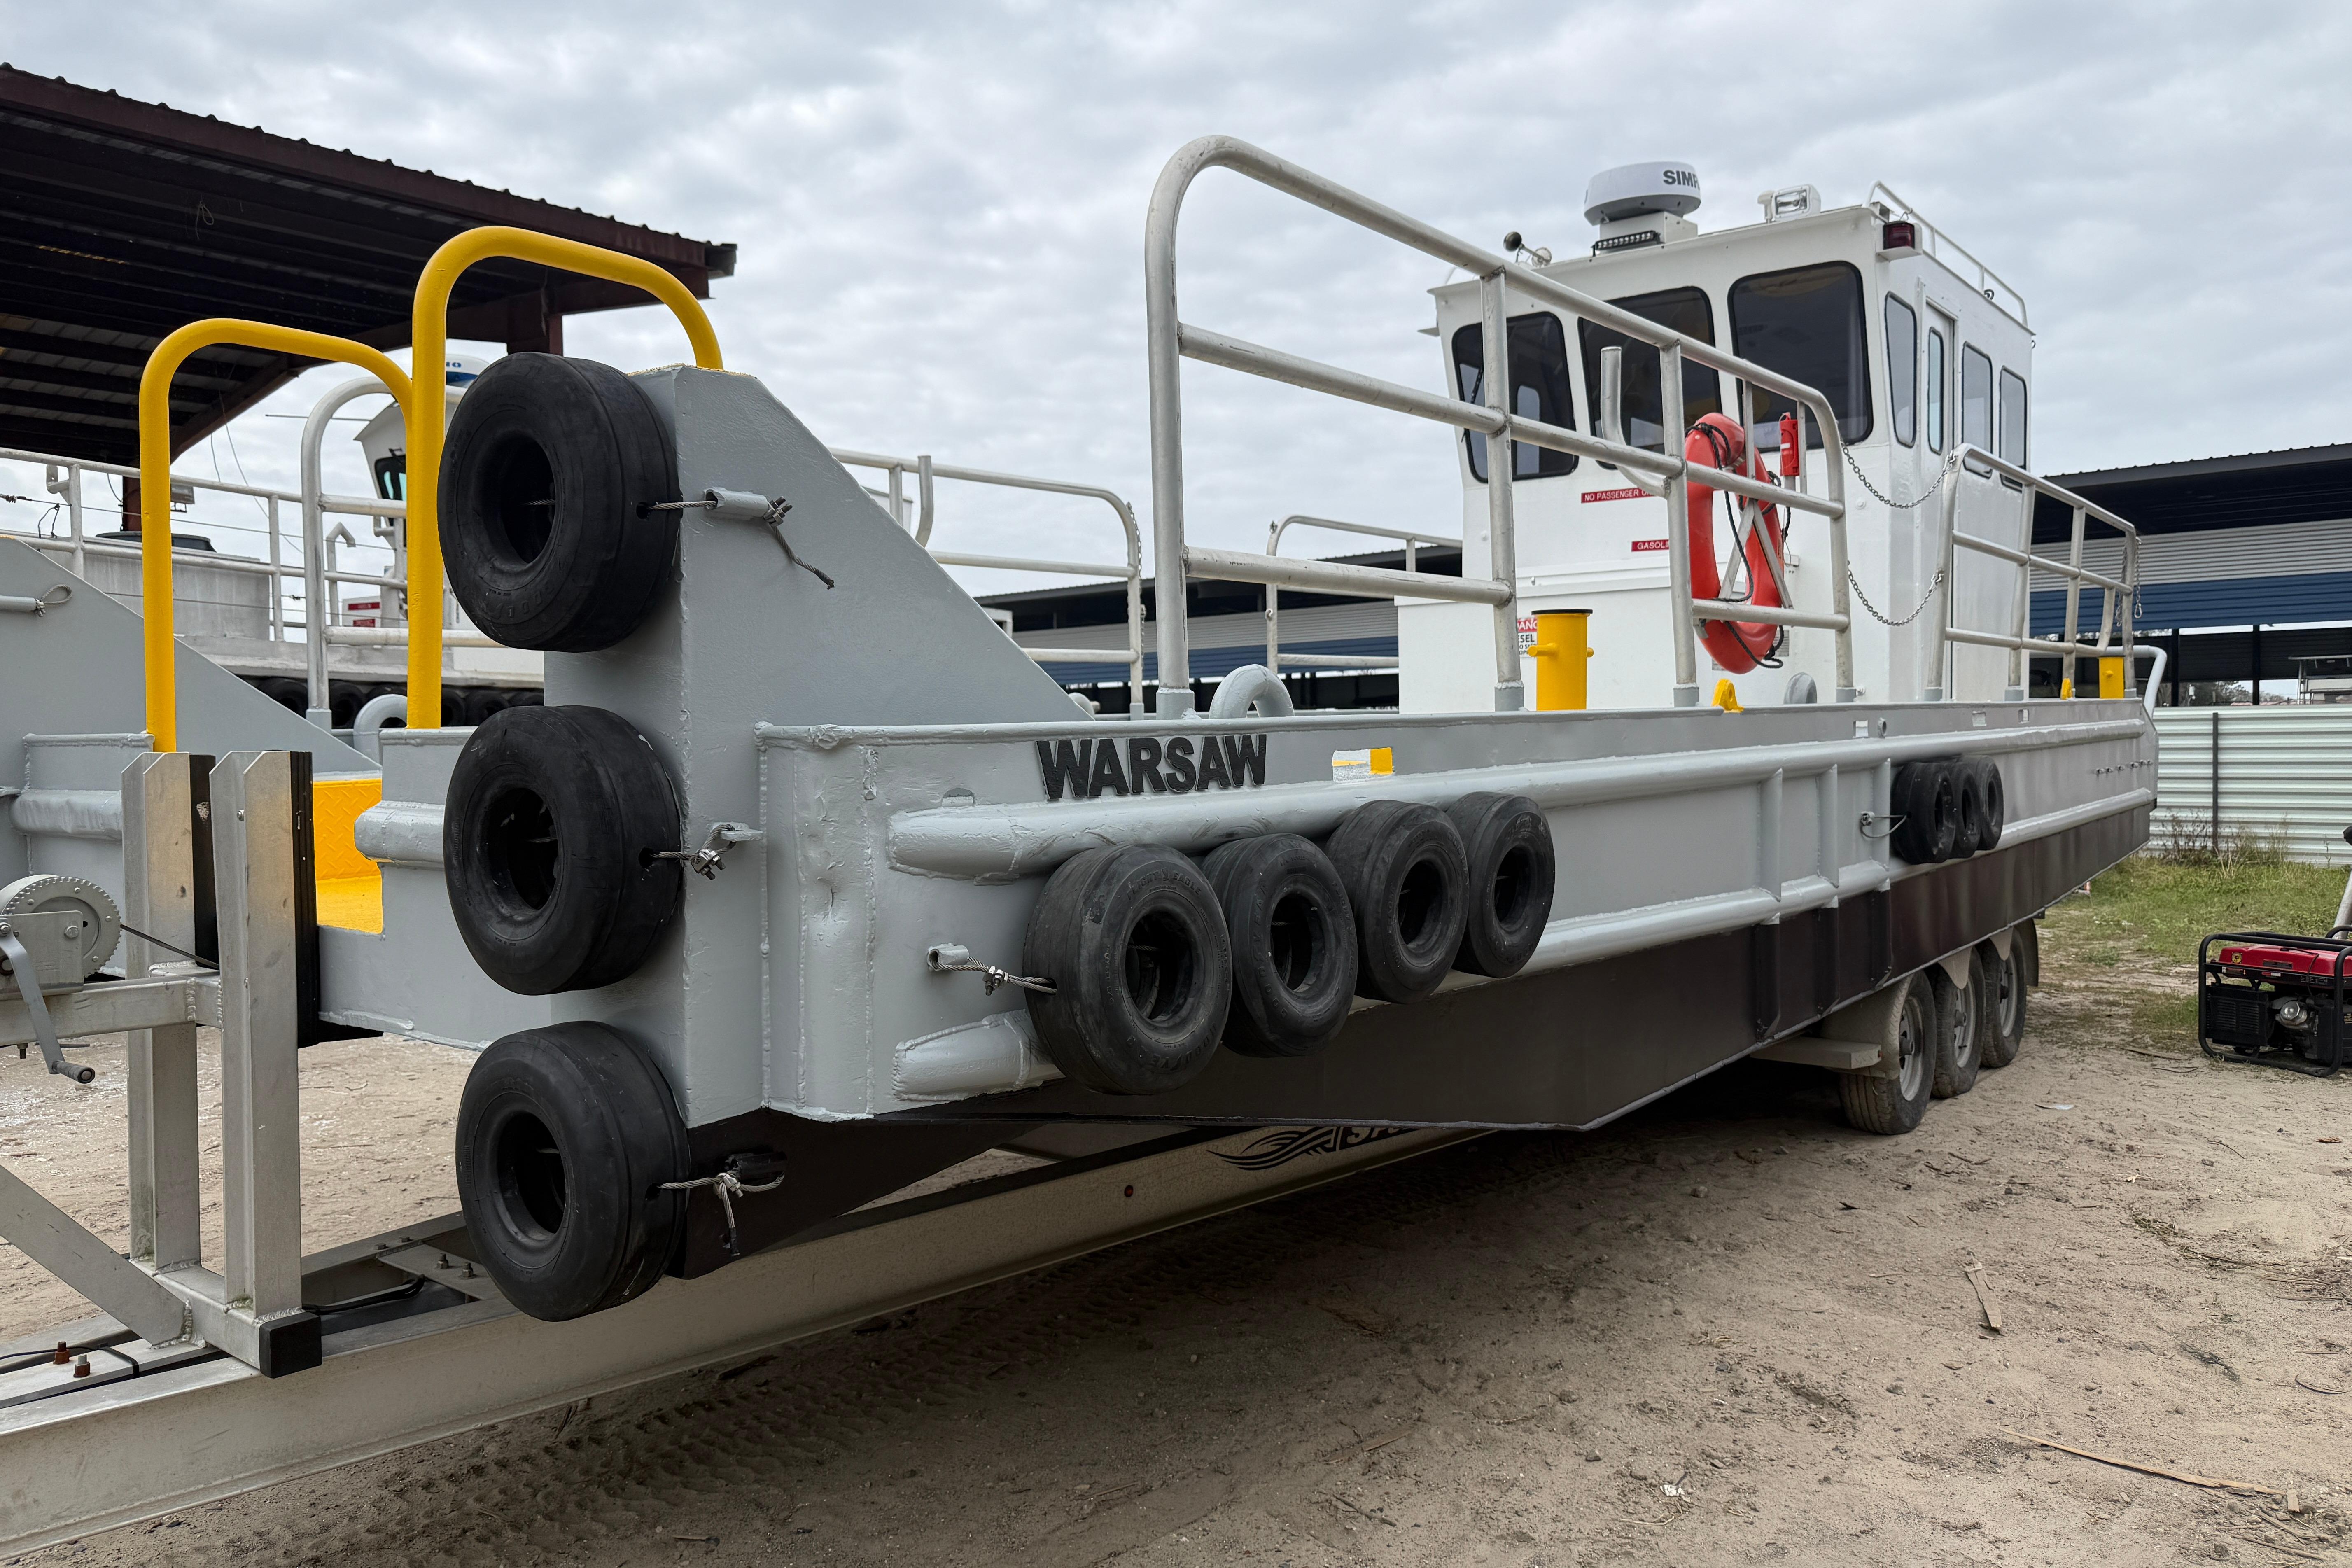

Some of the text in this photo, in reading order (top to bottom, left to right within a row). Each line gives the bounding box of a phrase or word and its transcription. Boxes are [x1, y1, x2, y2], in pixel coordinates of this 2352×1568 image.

[1596, 488, 1639, 500] PASSENGER
[1518, 634, 1535, 643] SEL
[1036, 734, 1267, 800] WARSAW
